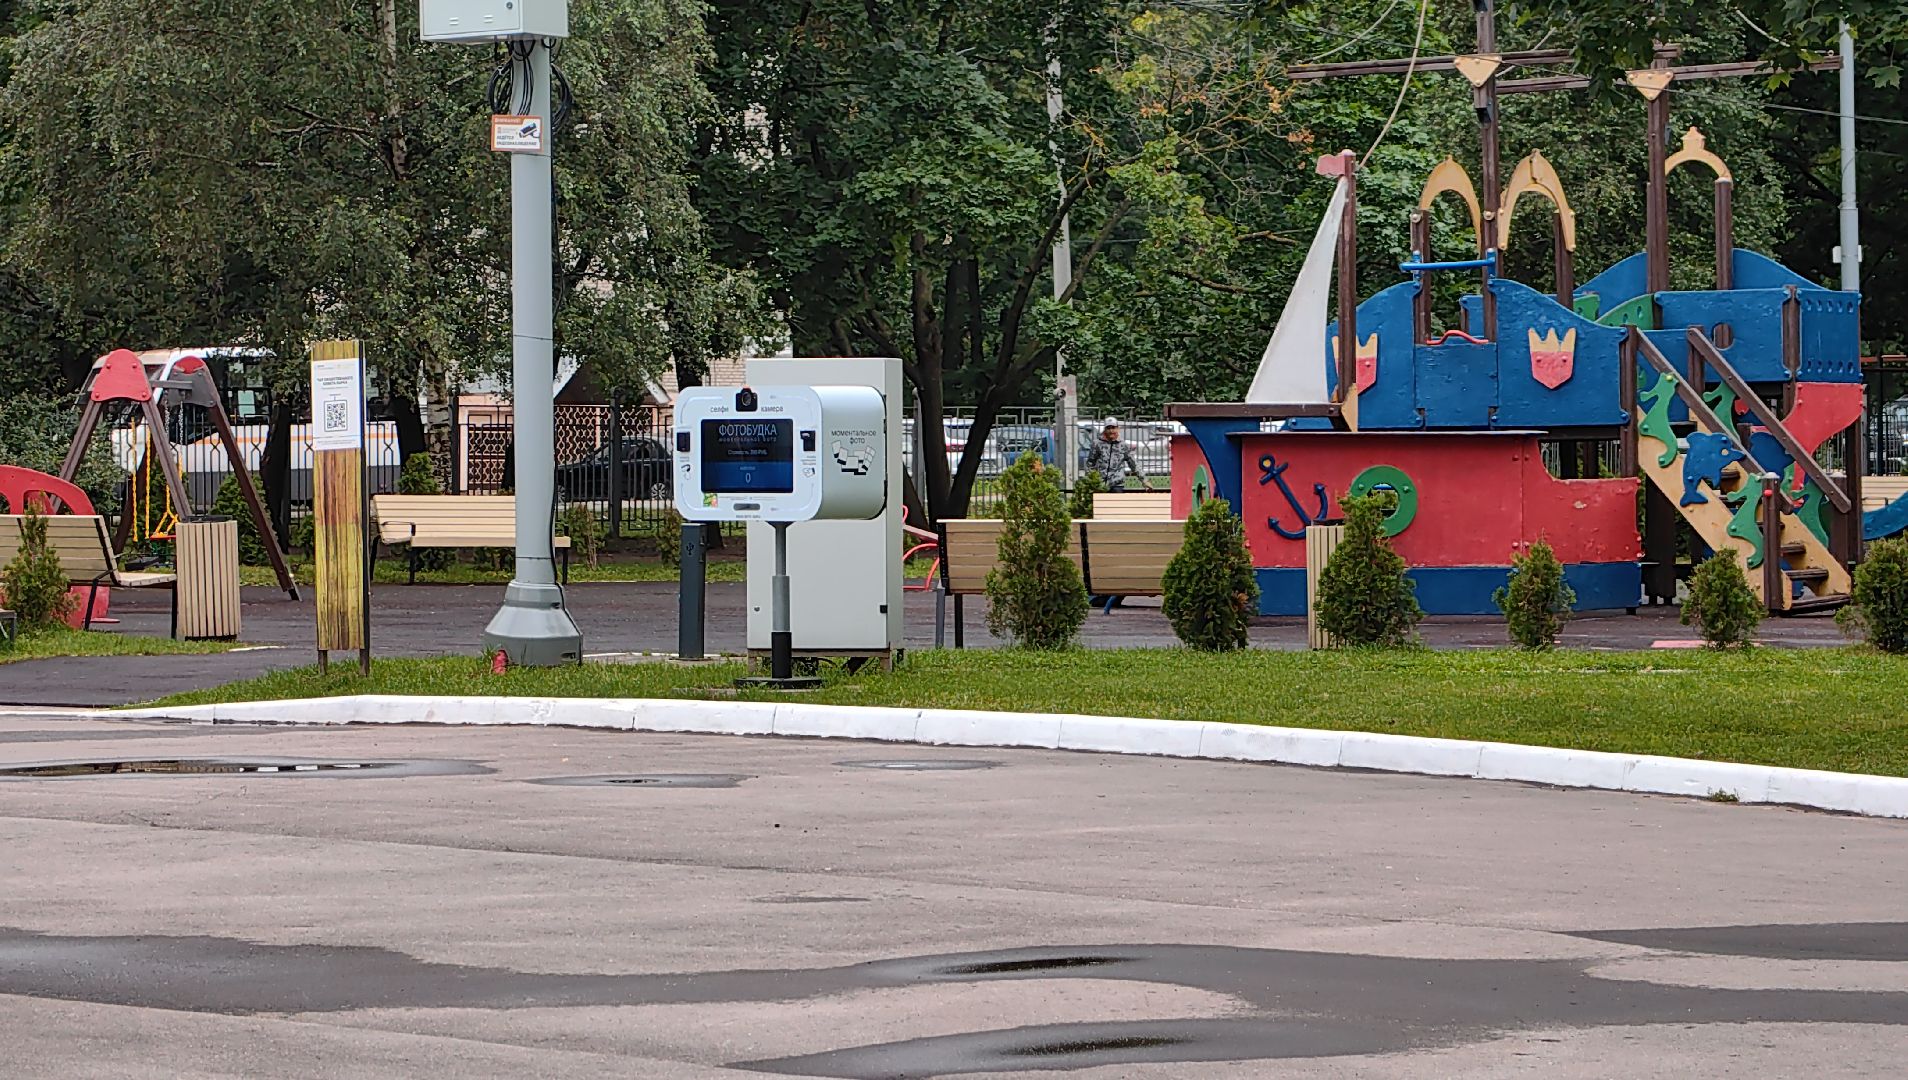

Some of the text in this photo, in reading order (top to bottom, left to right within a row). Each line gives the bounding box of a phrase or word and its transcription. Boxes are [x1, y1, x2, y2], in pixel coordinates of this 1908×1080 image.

[710, 405, 784, 414] селфи камера
[718, 423, 777, 437] ФОТОБУДКА
